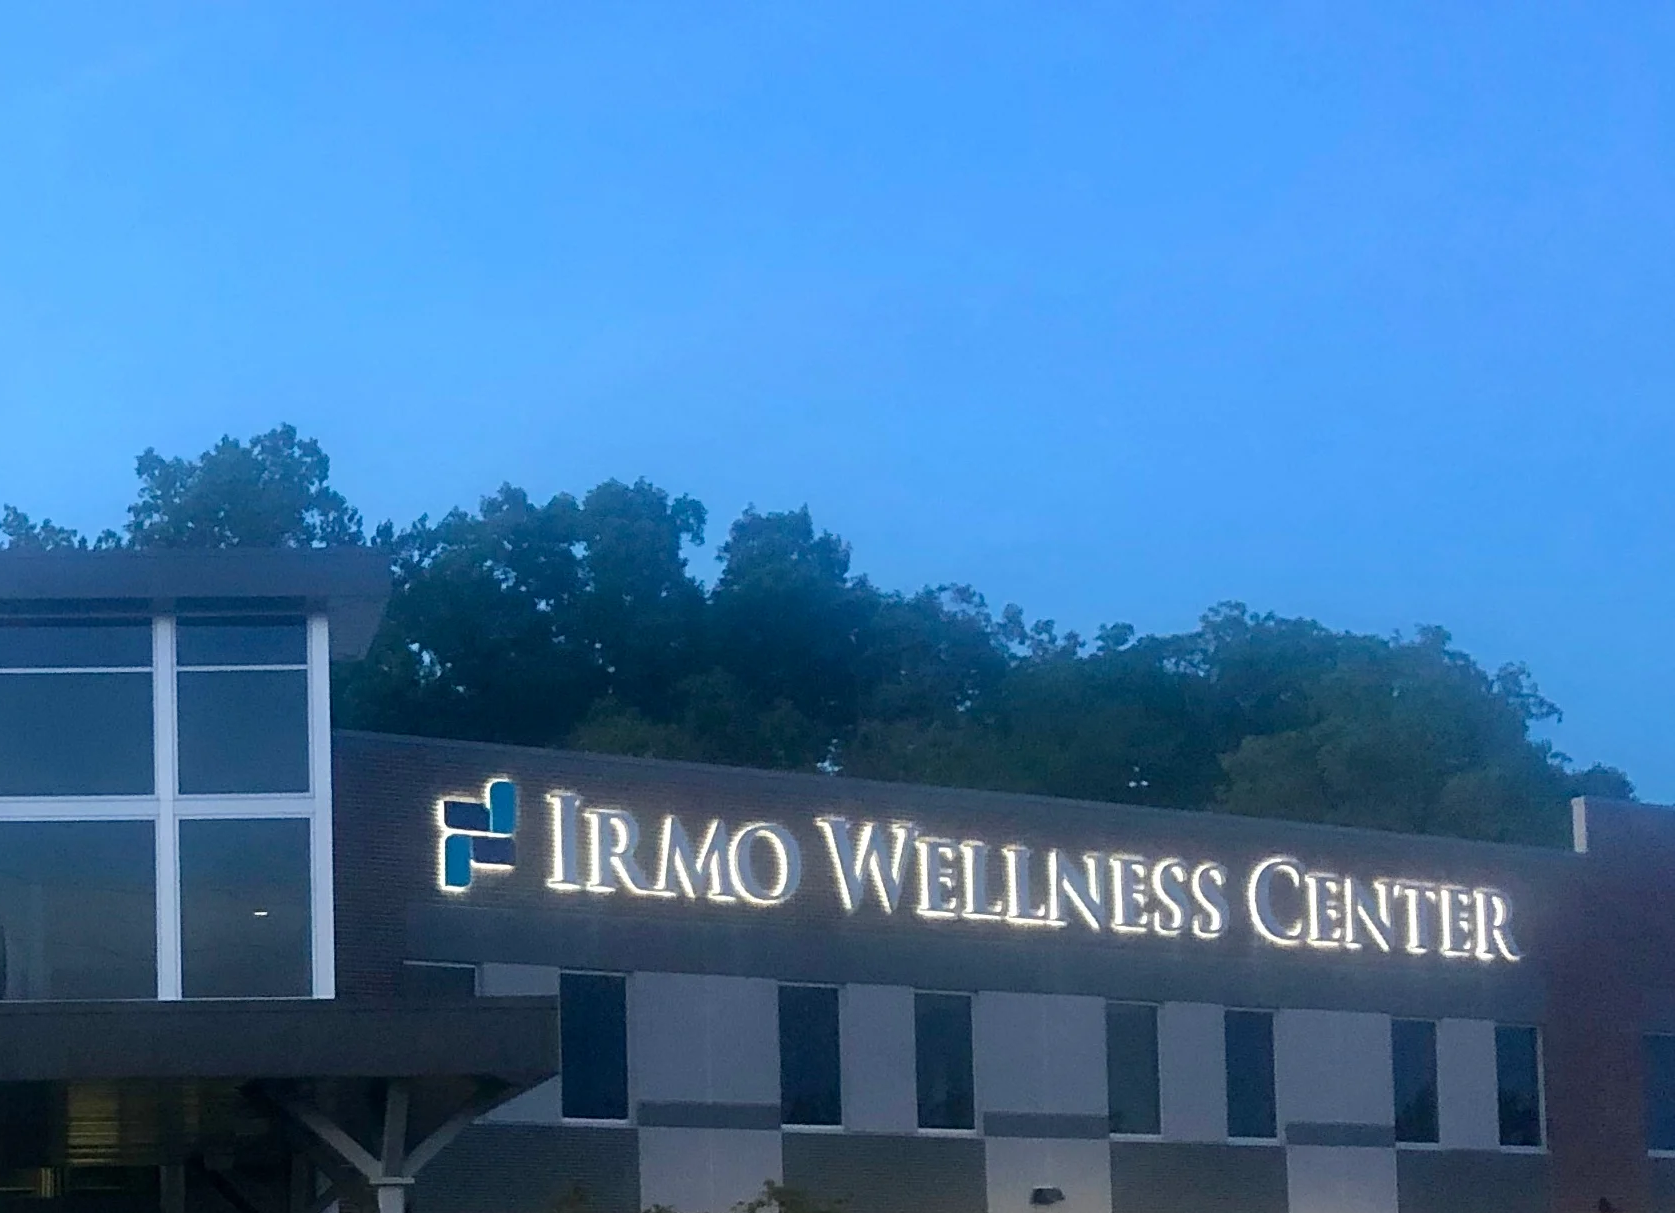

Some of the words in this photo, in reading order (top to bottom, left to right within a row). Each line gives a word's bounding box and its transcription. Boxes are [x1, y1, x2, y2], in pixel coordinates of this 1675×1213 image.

[544, 788, 802, 905] IRMO
[812, 815, 1228, 939] WELLNESS
[1247, 855, 1524, 962] CENTER
